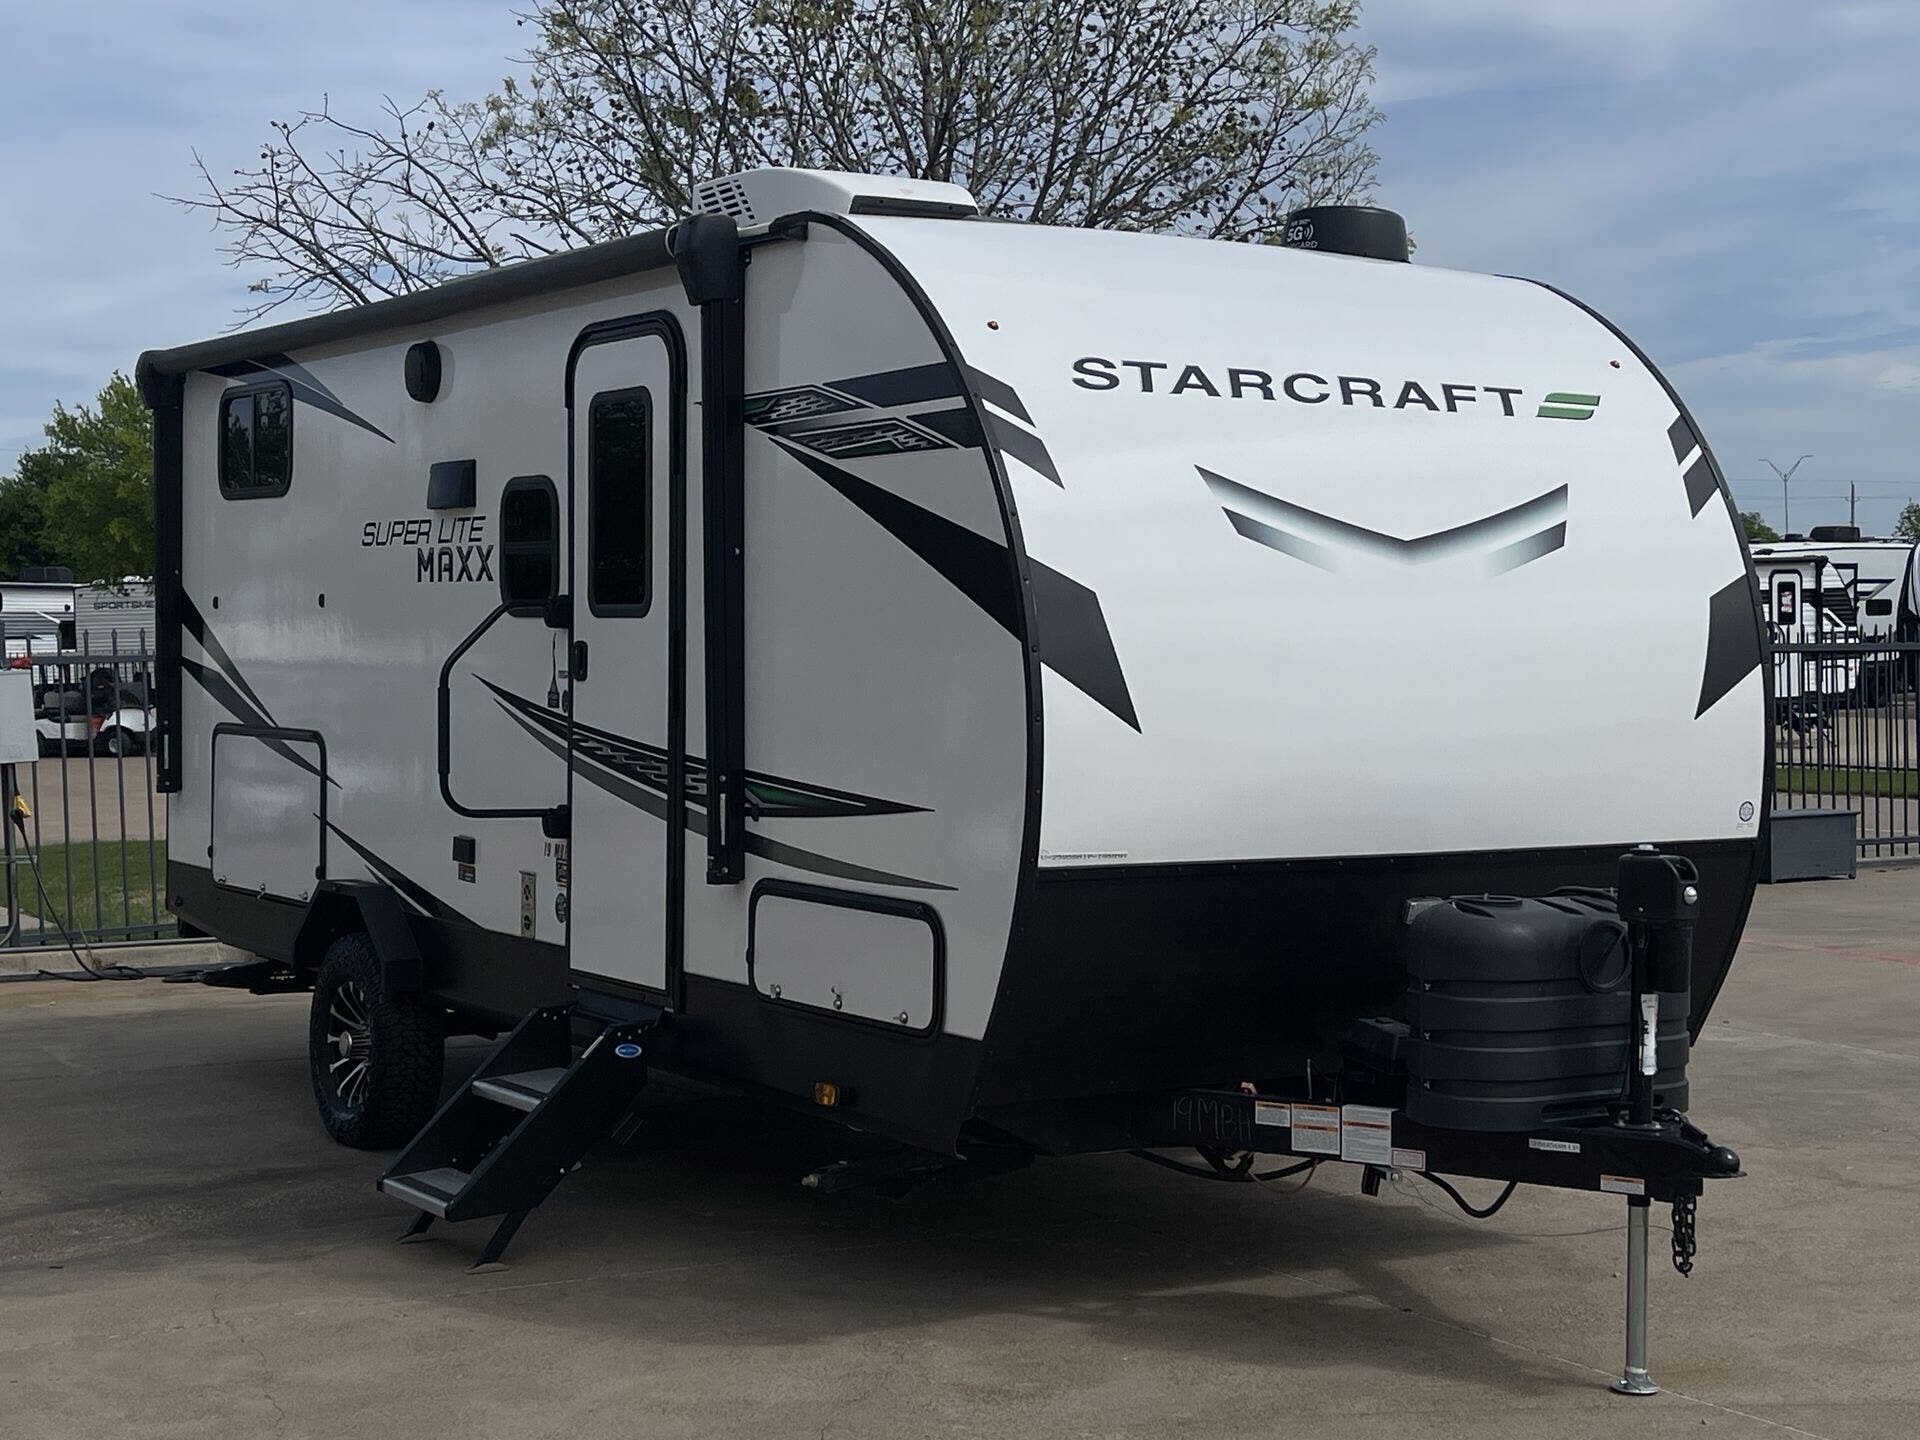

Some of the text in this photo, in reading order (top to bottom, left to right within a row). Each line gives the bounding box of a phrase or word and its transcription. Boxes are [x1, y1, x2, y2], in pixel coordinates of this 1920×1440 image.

[1287, 227, 1304, 242] 5G
[1072, 356, 1523, 417] STARCRAFT
[362, 515, 486, 547] SUPER LITE
[417, 544, 494, 583] MAXX
[93, 600, 156, 610] SPORTSME
